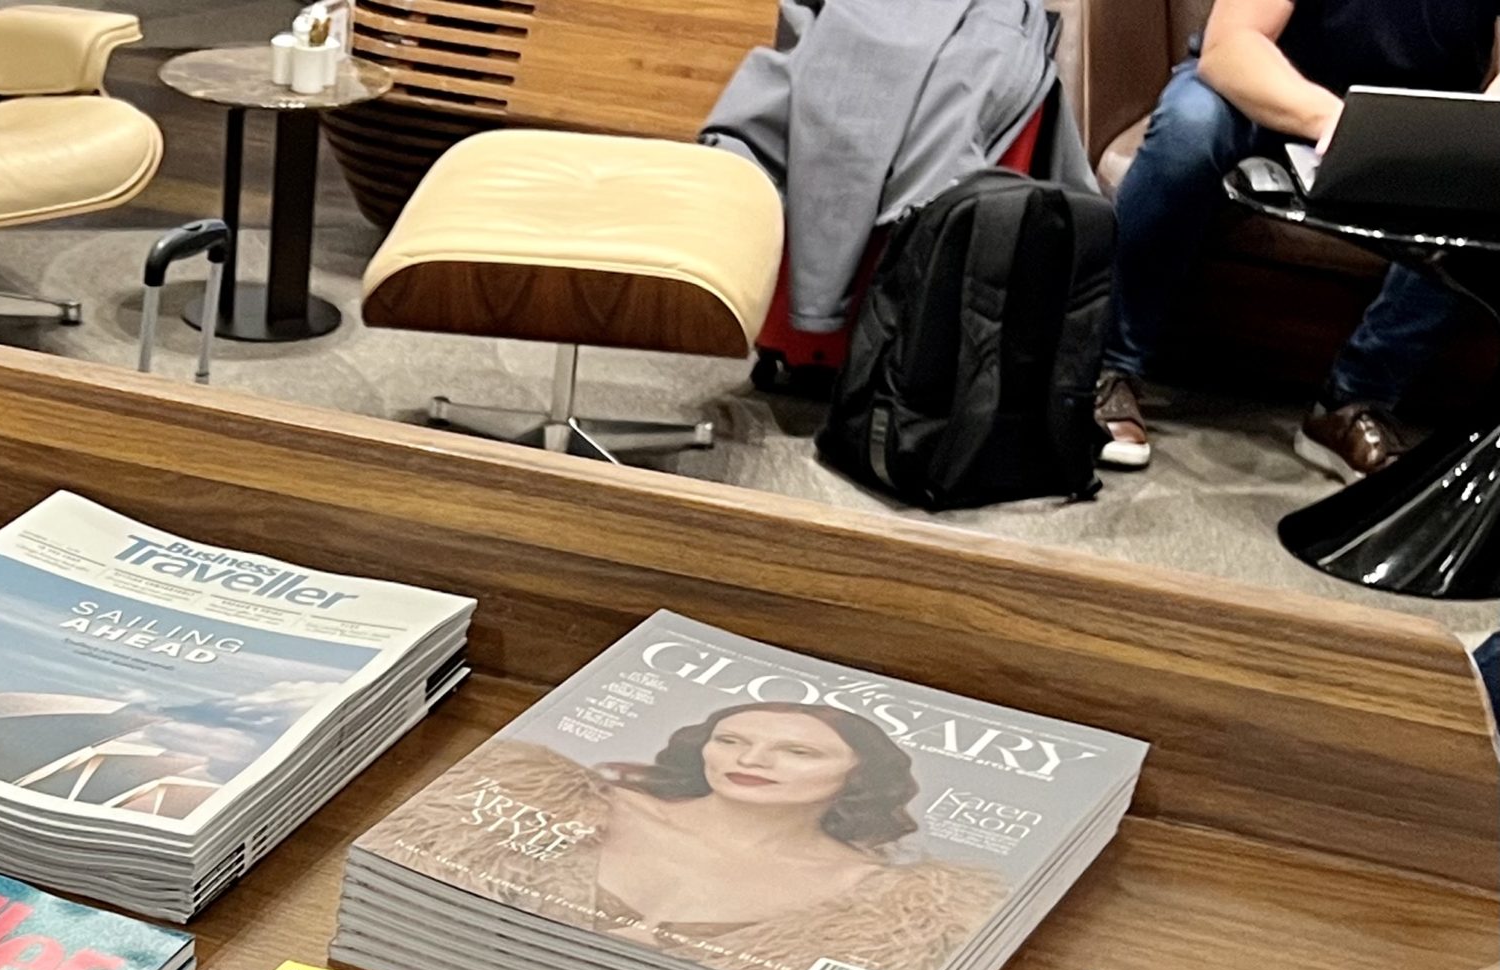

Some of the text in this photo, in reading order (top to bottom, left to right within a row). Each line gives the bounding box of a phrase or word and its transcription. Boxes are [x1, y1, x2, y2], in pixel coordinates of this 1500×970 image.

[113, 534, 358, 609] Traveller
[161, 541, 279, 579] Business
[60, 617, 218, 663] AHEAD
[71, 601, 245, 653] SAILING
[642, 641, 1097, 777] GLOSSARY
[830, 675, 898, 703] The
[454, 789, 595, 845] ARTS &
[927, 801, 1031, 838] Elson
[937, 788, 1043, 825] Karen
[460, 808, 568, 851] STYLE
